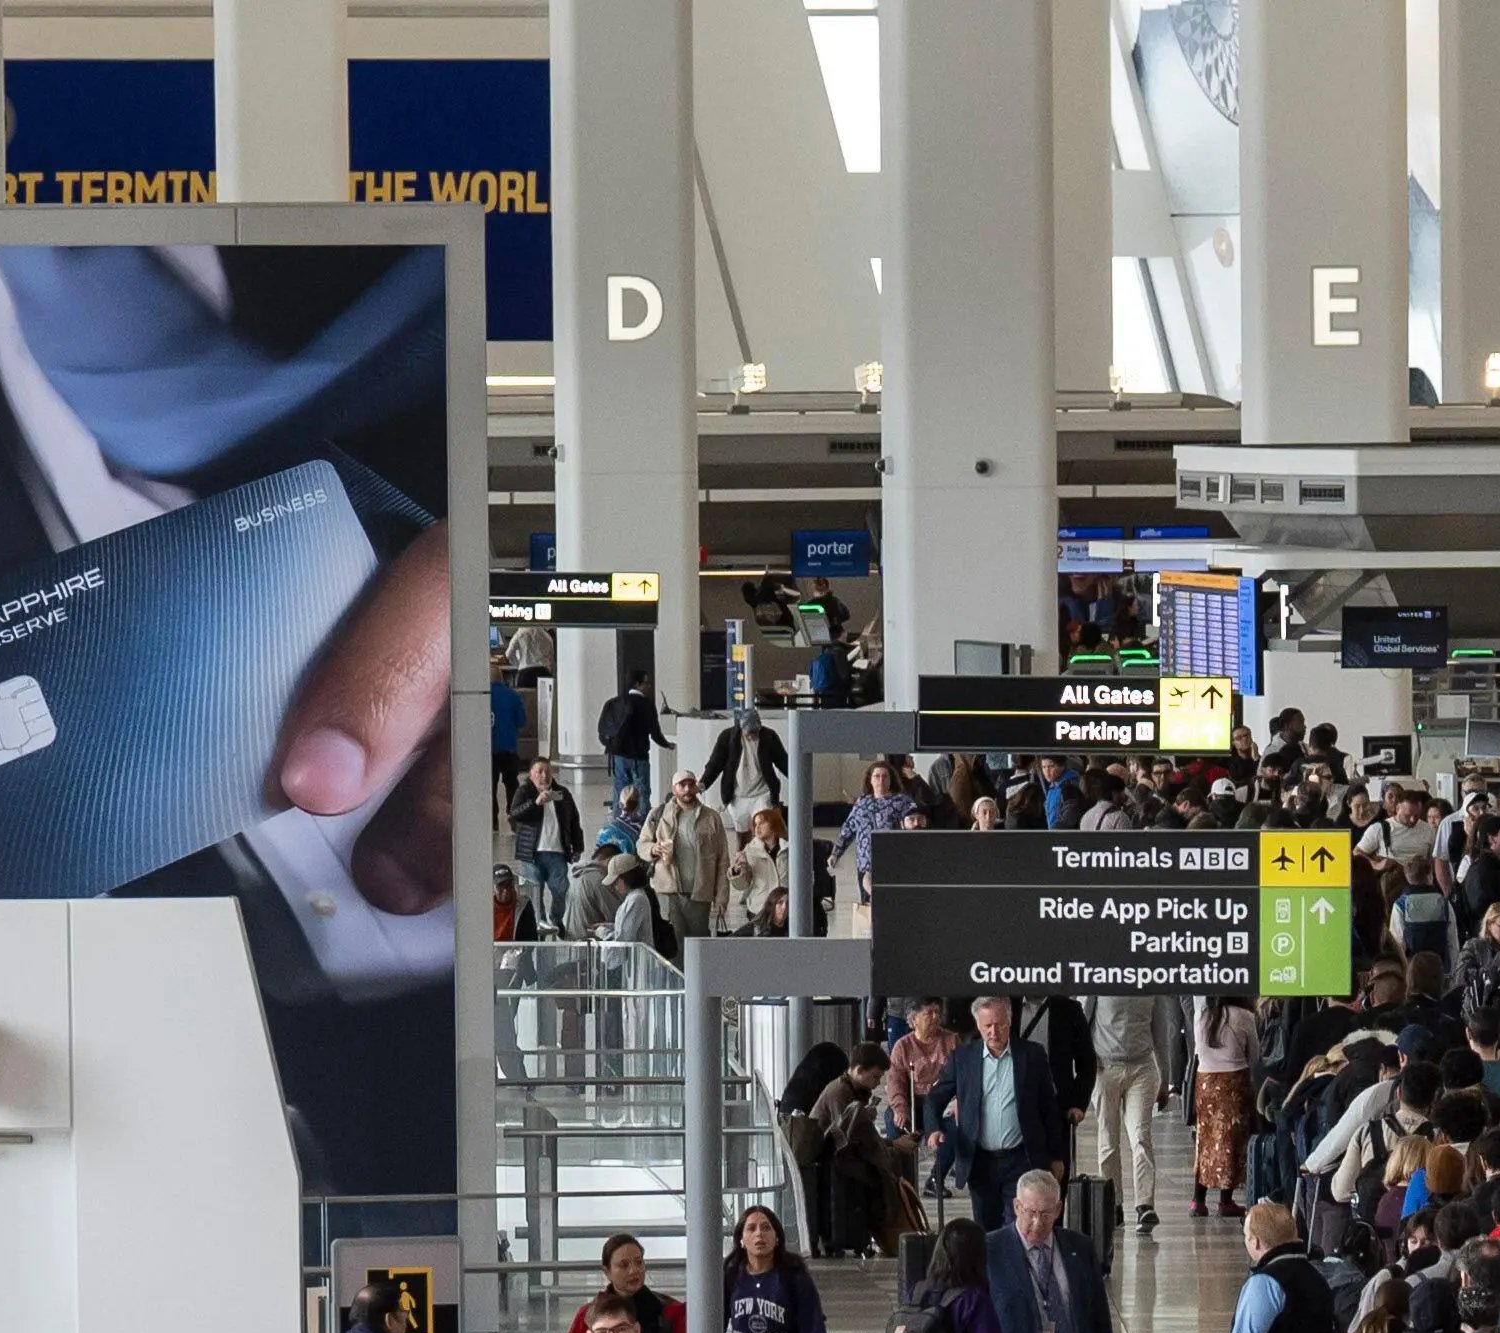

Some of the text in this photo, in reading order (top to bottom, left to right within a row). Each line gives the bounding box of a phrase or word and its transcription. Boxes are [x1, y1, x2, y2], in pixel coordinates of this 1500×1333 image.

[607, 276, 663, 341] D
[1313, 268, 1359, 345] E
[234, 488, 328, 532] BUSINESS
[807, 541, 854, 557] porter
[548, 578, 610, 594] All Gates
[1373, 635, 1401, 644] United
[1373, 644, 1400, 653] Global
[1059, 684, 1155, 706] All Gates
[1056, 721, 1132, 745] Parking
[1052, 846, 1173, 869] Terminals
[1040, 897, 1248, 923] Ride App Pick Up
[1131, 931, 1222, 959] Parking
[970, 961, 1249, 989] Ground Transportation
[756, 1297, 786, 1324] YORK
